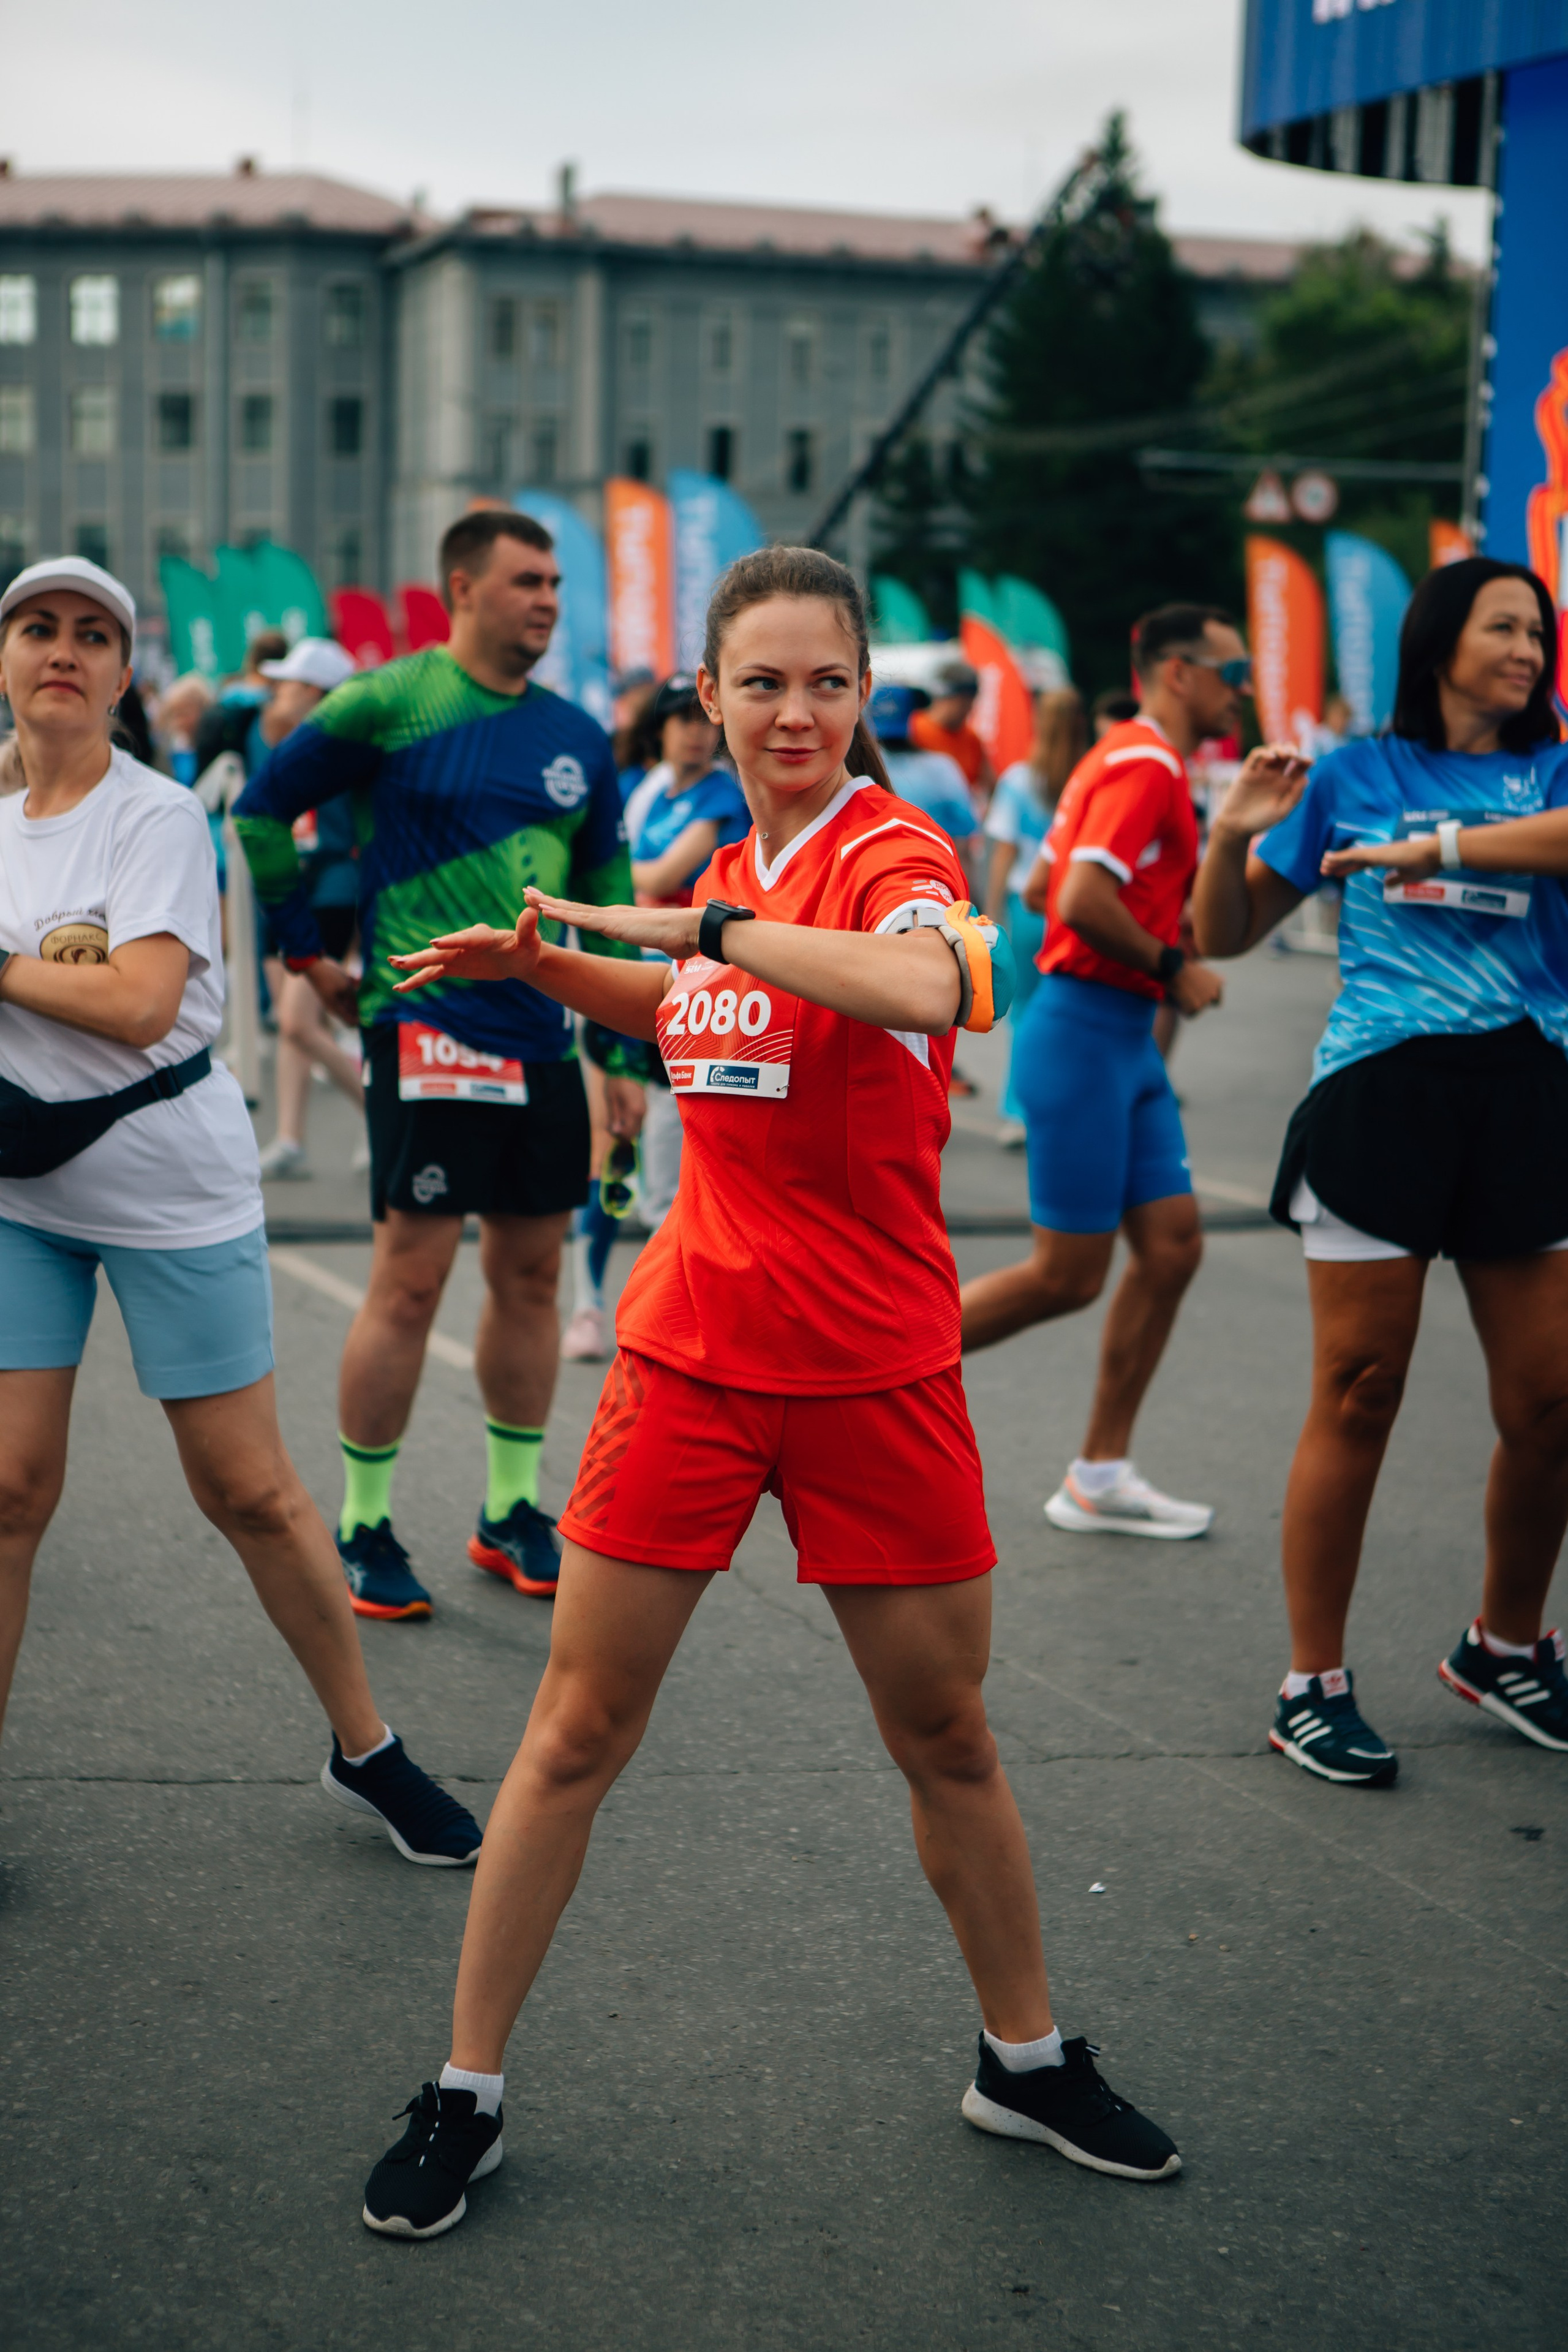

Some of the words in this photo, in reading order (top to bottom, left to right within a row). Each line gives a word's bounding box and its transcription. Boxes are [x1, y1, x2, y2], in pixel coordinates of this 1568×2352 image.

[50, 932, 103, 944] ФОРНАКС
[666, 989, 772, 1037] 2080
[681, 1071, 692, 1079] Банк
[714, 1072, 756, 1084] Следопыт
